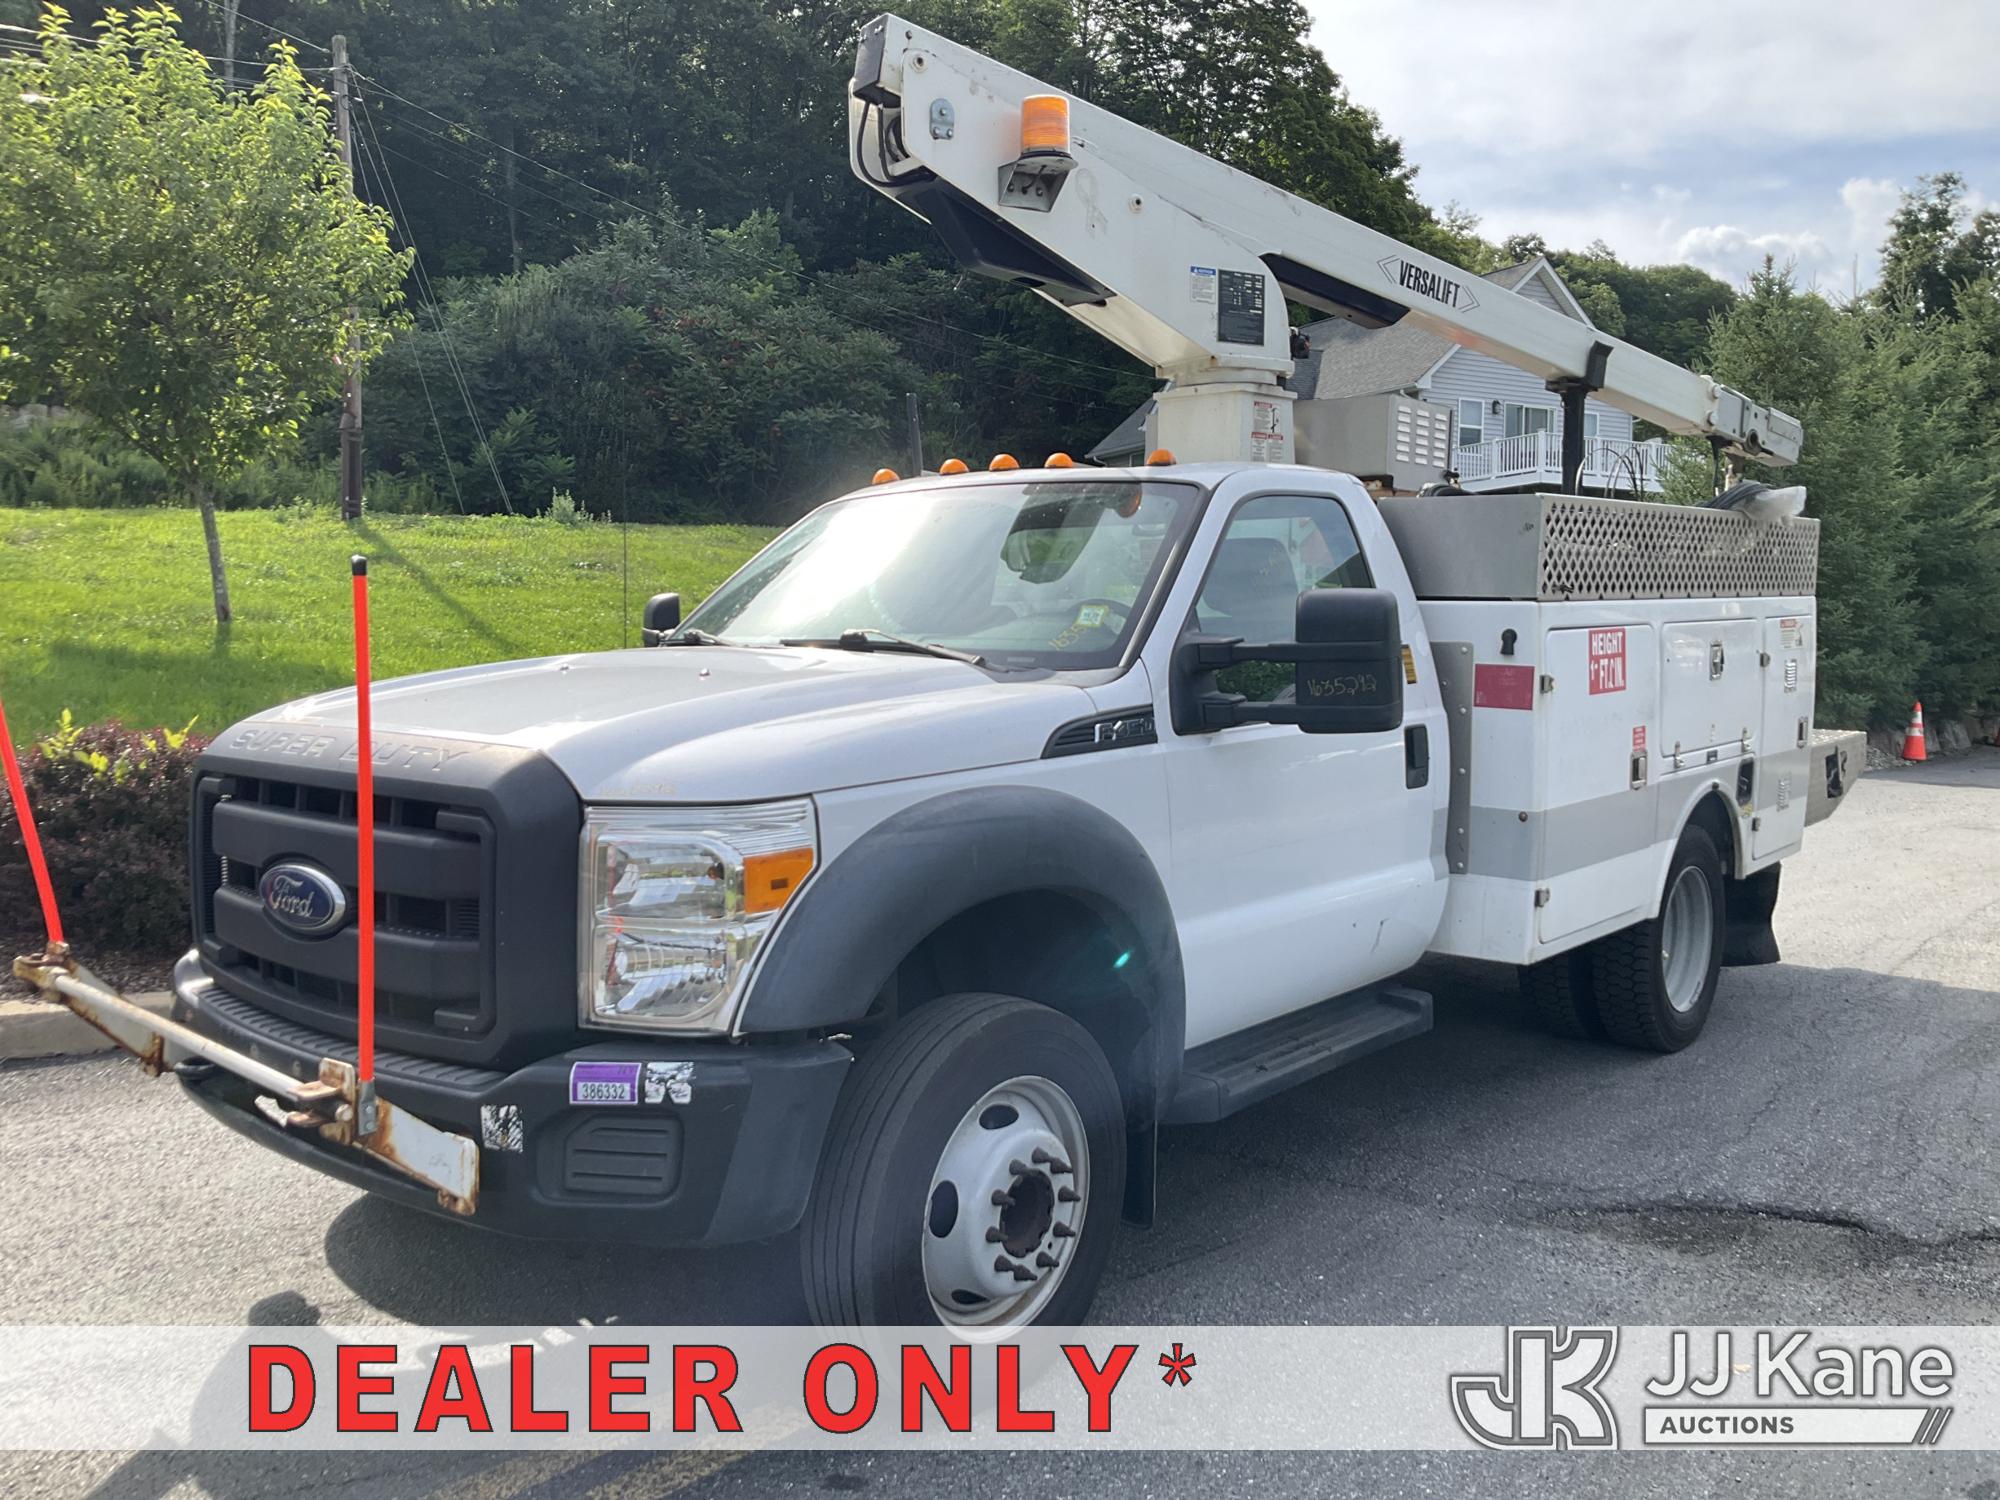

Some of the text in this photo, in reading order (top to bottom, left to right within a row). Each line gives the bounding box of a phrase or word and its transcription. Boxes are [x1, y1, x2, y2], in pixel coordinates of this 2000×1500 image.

[1399, 260, 1460, 308] VERSALIFT
[1591, 631, 1623, 656] HEIGHT
[230, 729, 337, 758] SUPER
[269, 874, 315, 917] Ford
[582, 1082, 627, 1100] 386332
